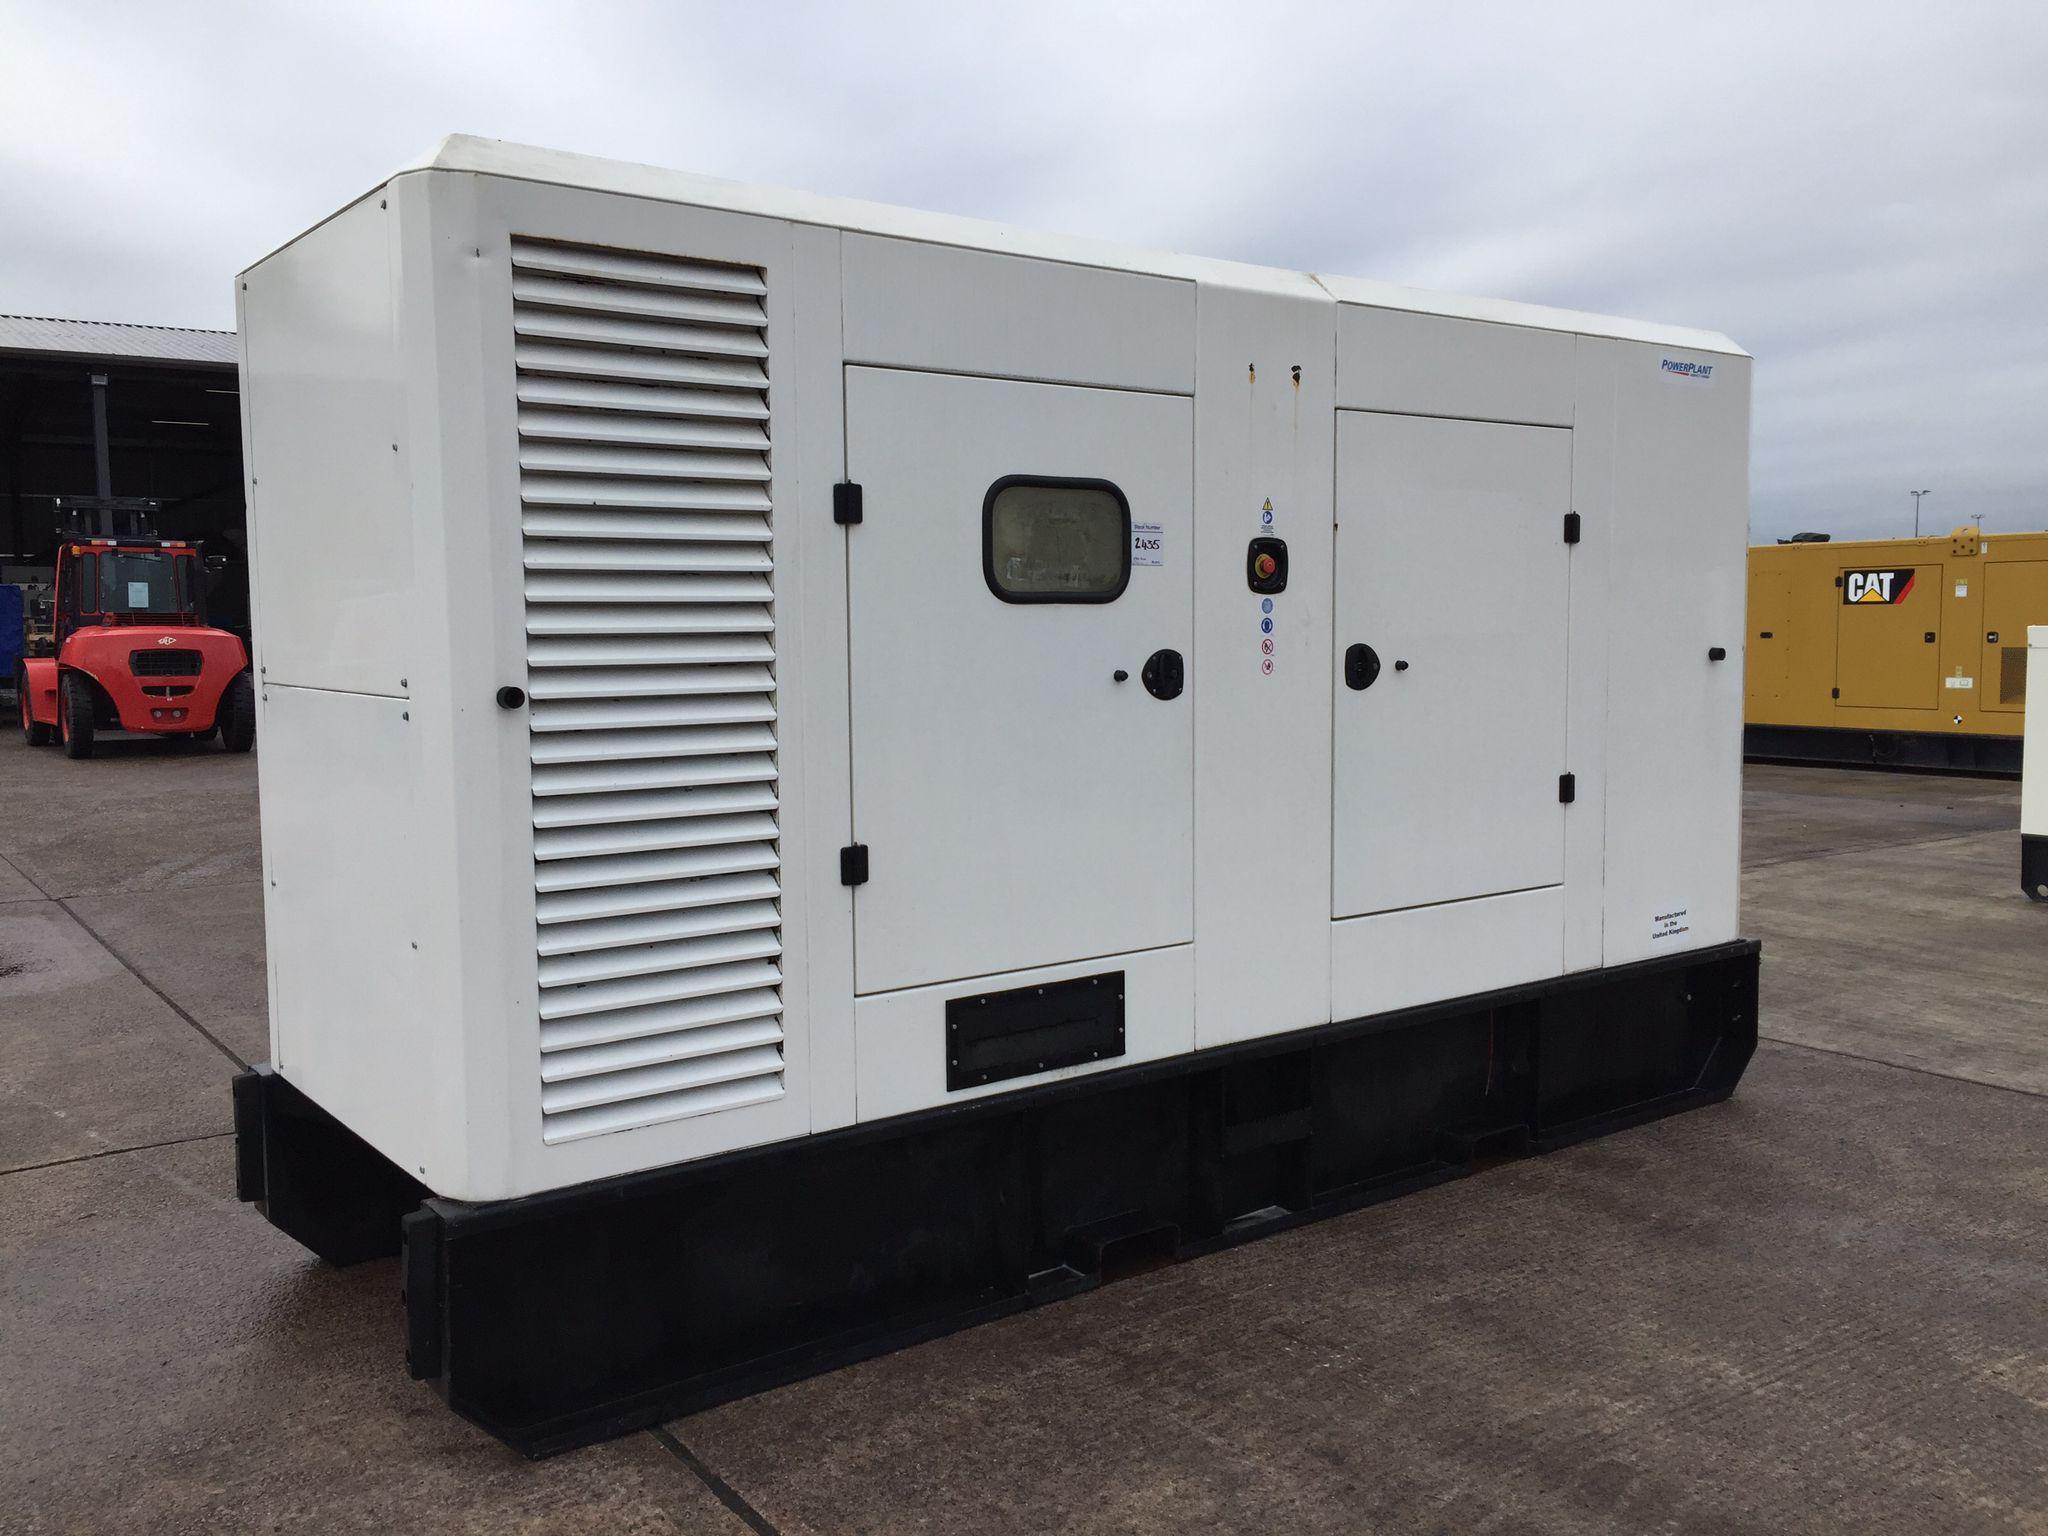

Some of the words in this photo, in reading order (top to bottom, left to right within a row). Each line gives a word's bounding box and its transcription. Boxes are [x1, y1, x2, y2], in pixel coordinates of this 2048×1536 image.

[1135, 537, 1161, 550] 2435
[1848, 572, 1894, 602] CAT
[1654, 909, 1687, 922] Manufactured
[1652, 930, 1668, 939] United
